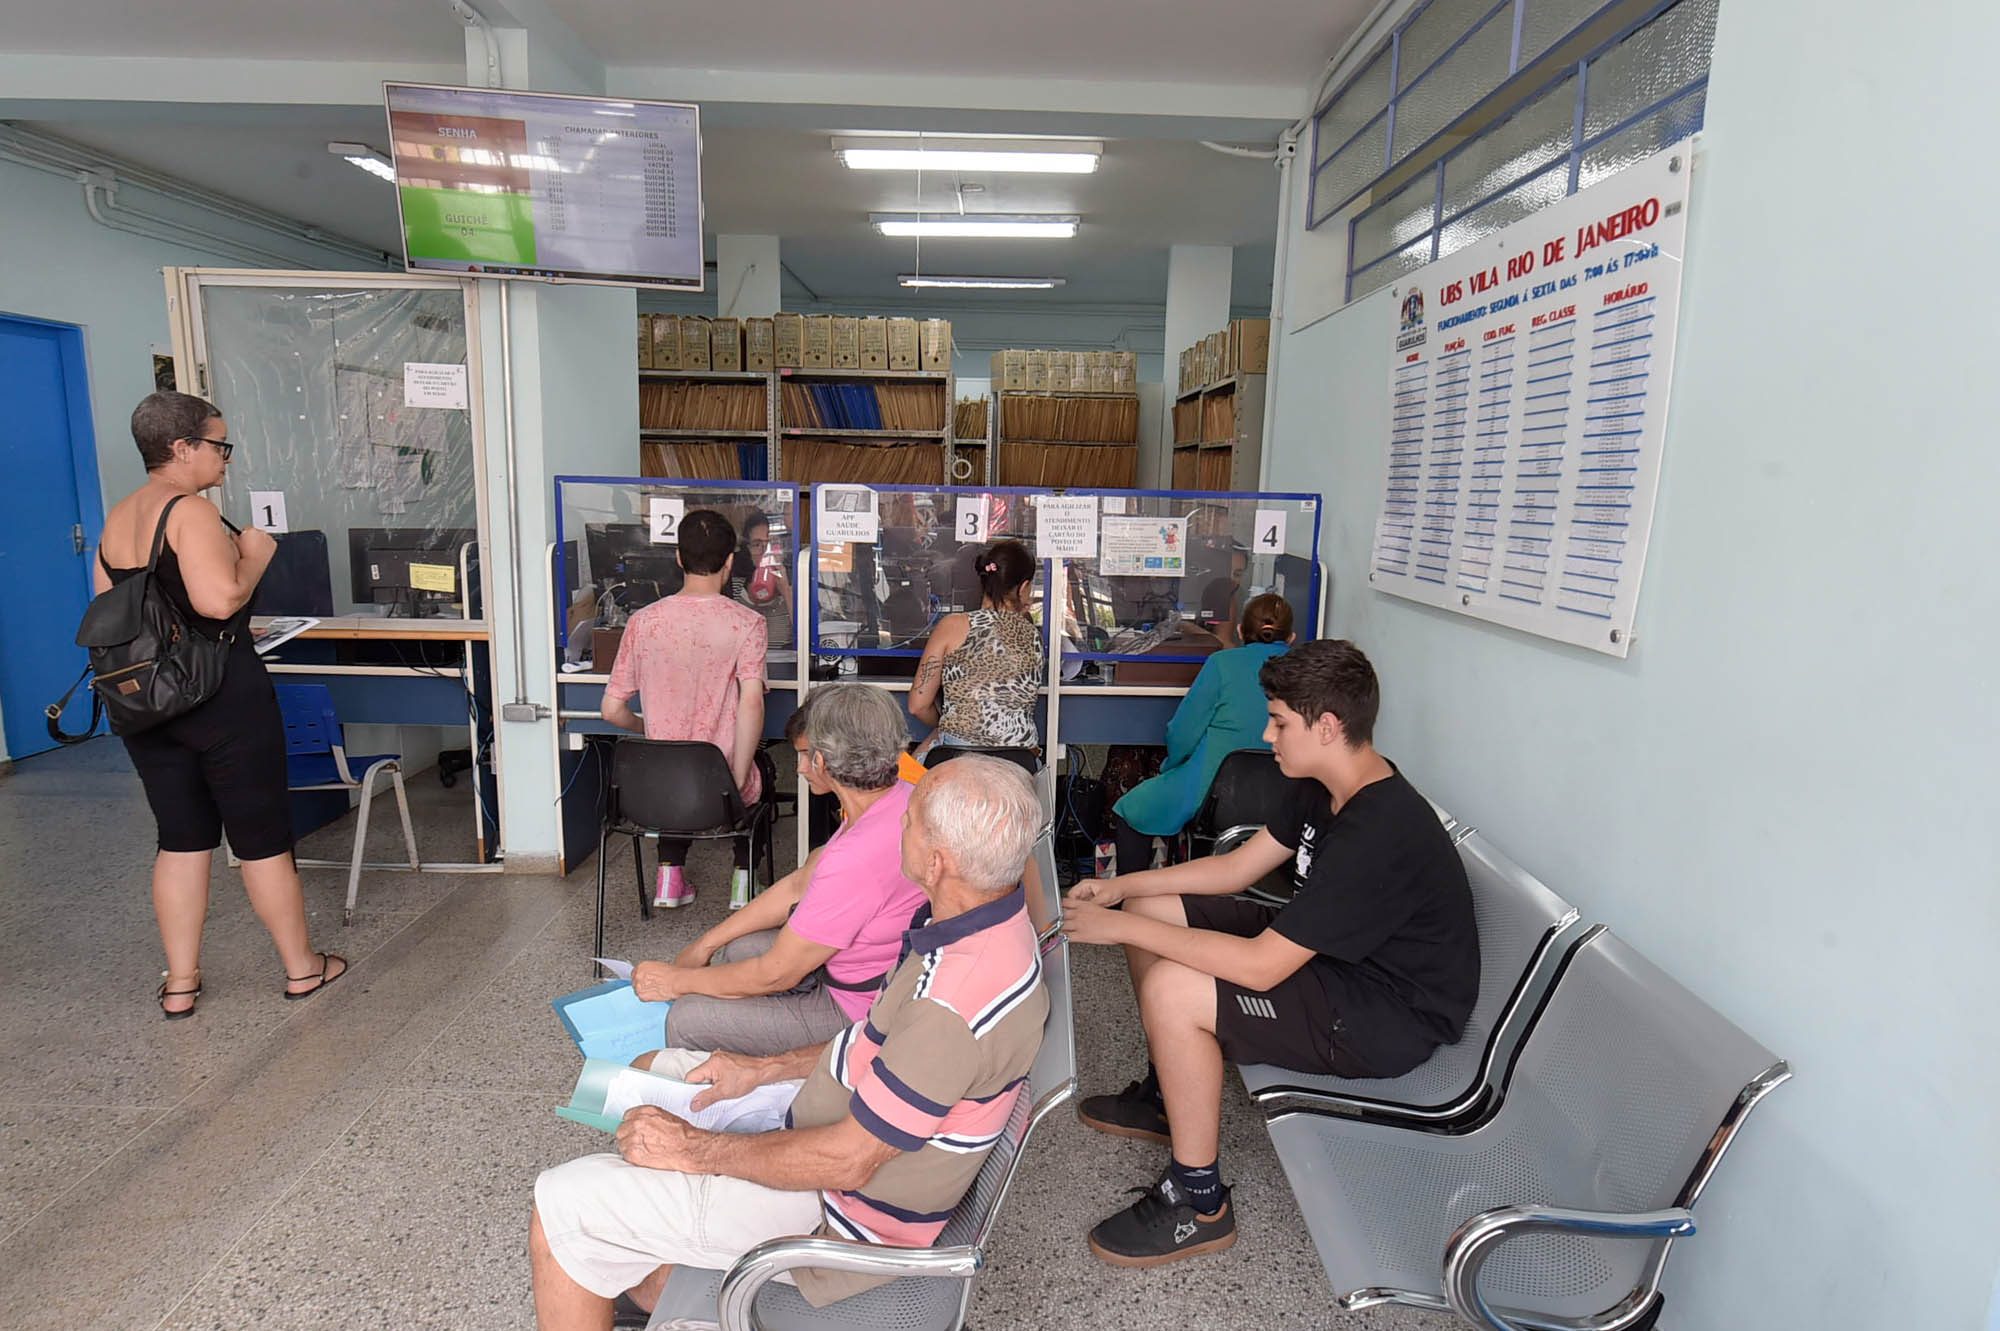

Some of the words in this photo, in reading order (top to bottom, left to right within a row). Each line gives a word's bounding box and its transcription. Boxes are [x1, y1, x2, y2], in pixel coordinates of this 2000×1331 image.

[438, 127, 477, 139] SENHA
[610, 129, 659, 141] NTERIORES
[1440, 280, 1464, 307] UBS
[1469, 267, 1498, 296] VILA
[1507, 250, 1534, 282] RIO
[1543, 237, 1565, 267] DE
[1574, 198, 1660, 259] JANEIRO
[1489, 294, 1519, 314] SEGUNDA
[1532, 280, 1556, 300] SEXTA
[1560, 274, 1577, 290] DAS
[1603, 282, 1648, 305] HORÁRIO
[1549, 304, 1576, 322] CLASSE
[262, 504, 277, 527] 1
[660, 513, 675, 537] 2
[964, 512, 979, 536] 3
[1262, 525, 1278, 548] 4
